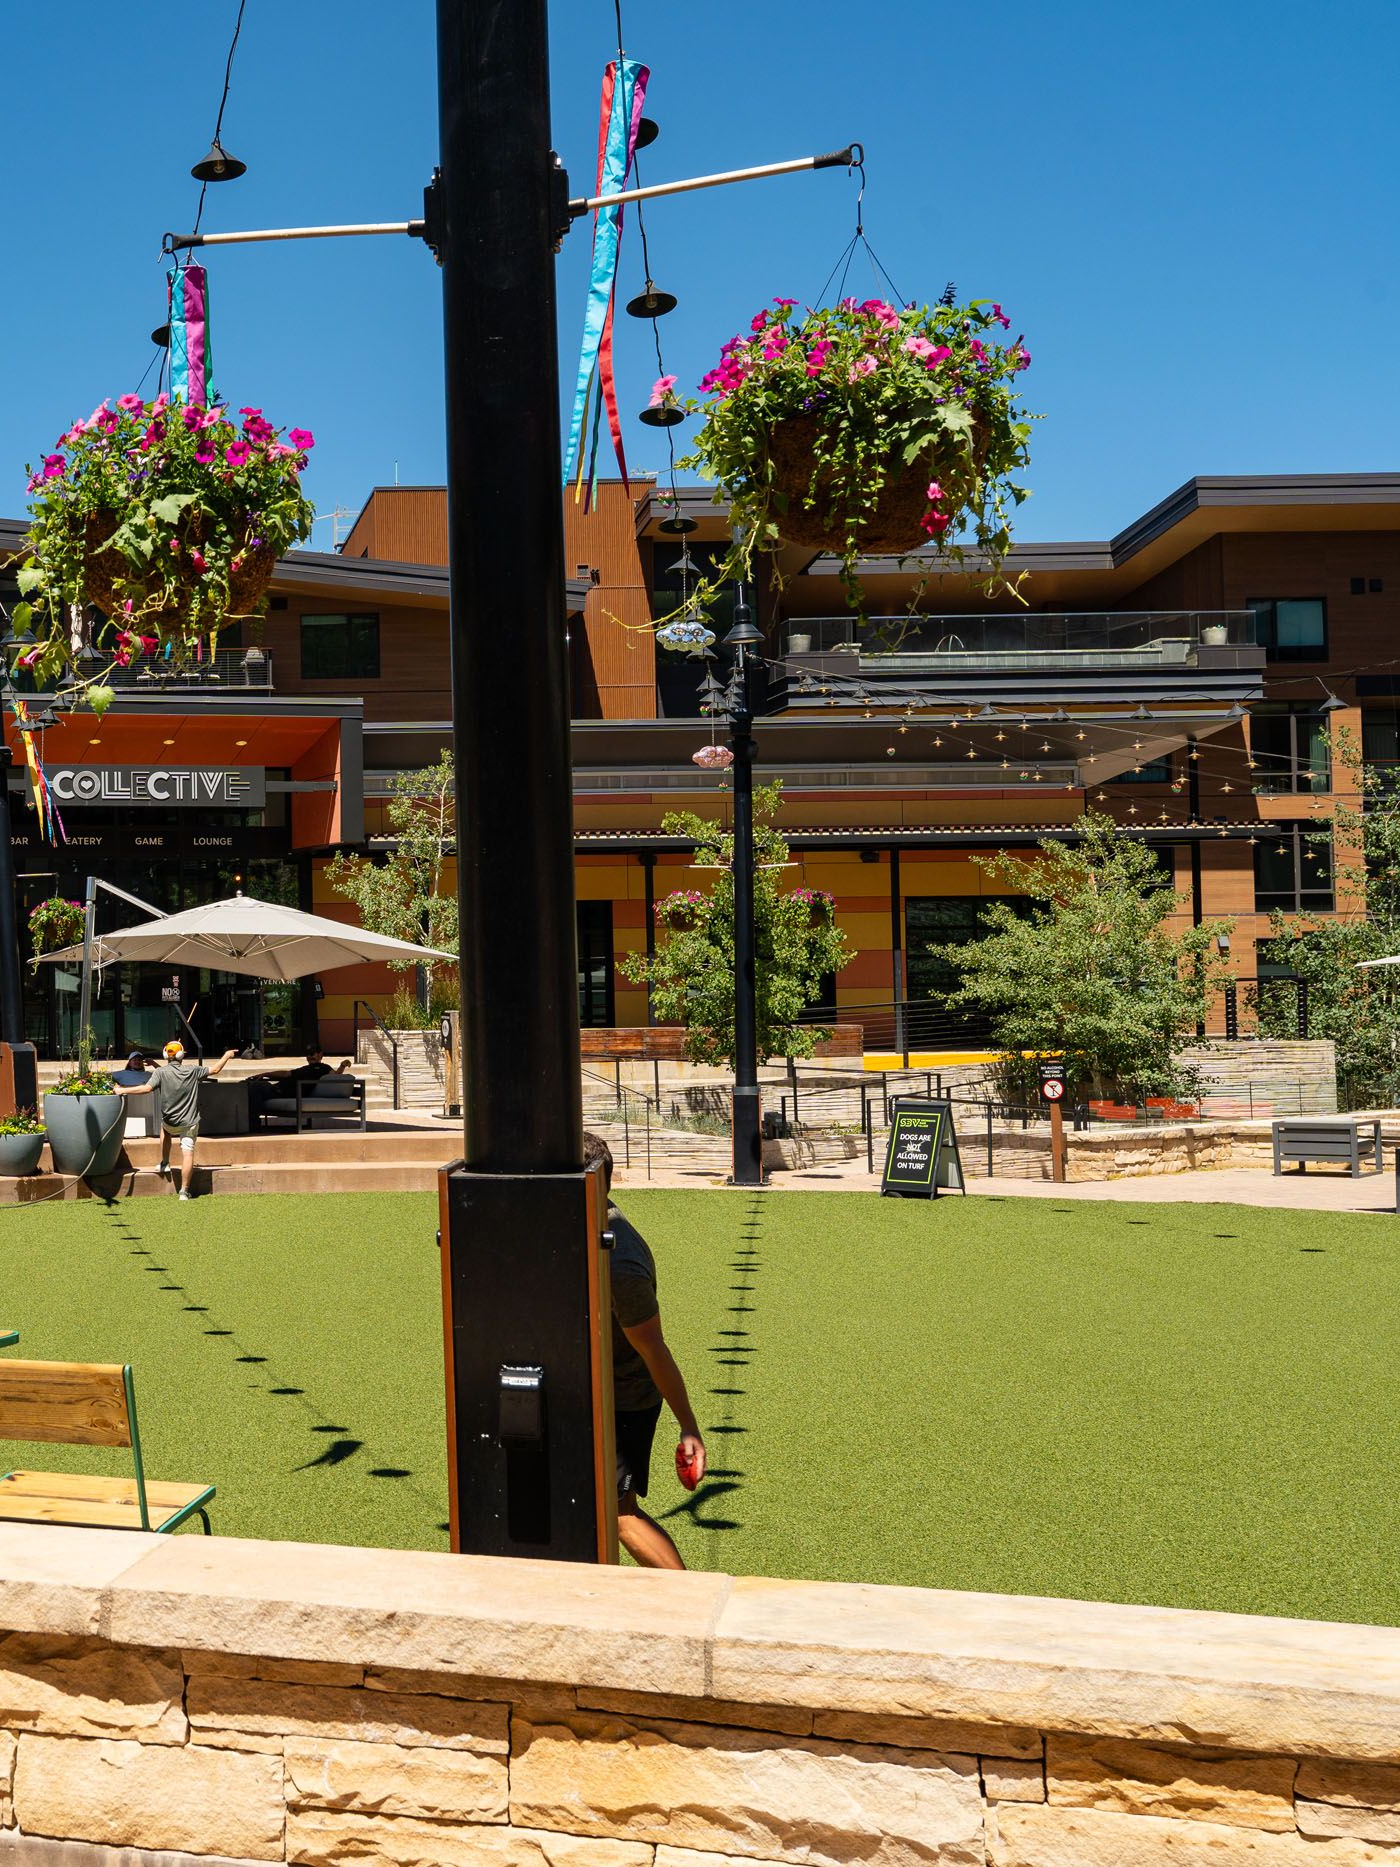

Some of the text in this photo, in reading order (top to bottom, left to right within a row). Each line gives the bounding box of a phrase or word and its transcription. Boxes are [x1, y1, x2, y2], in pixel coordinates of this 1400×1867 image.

[50, 771, 250, 801] COLLECTIVE
[10, 837, 233, 846] BAR EATERY GAME LOUNGE
[161, 987, 172, 996] NO
